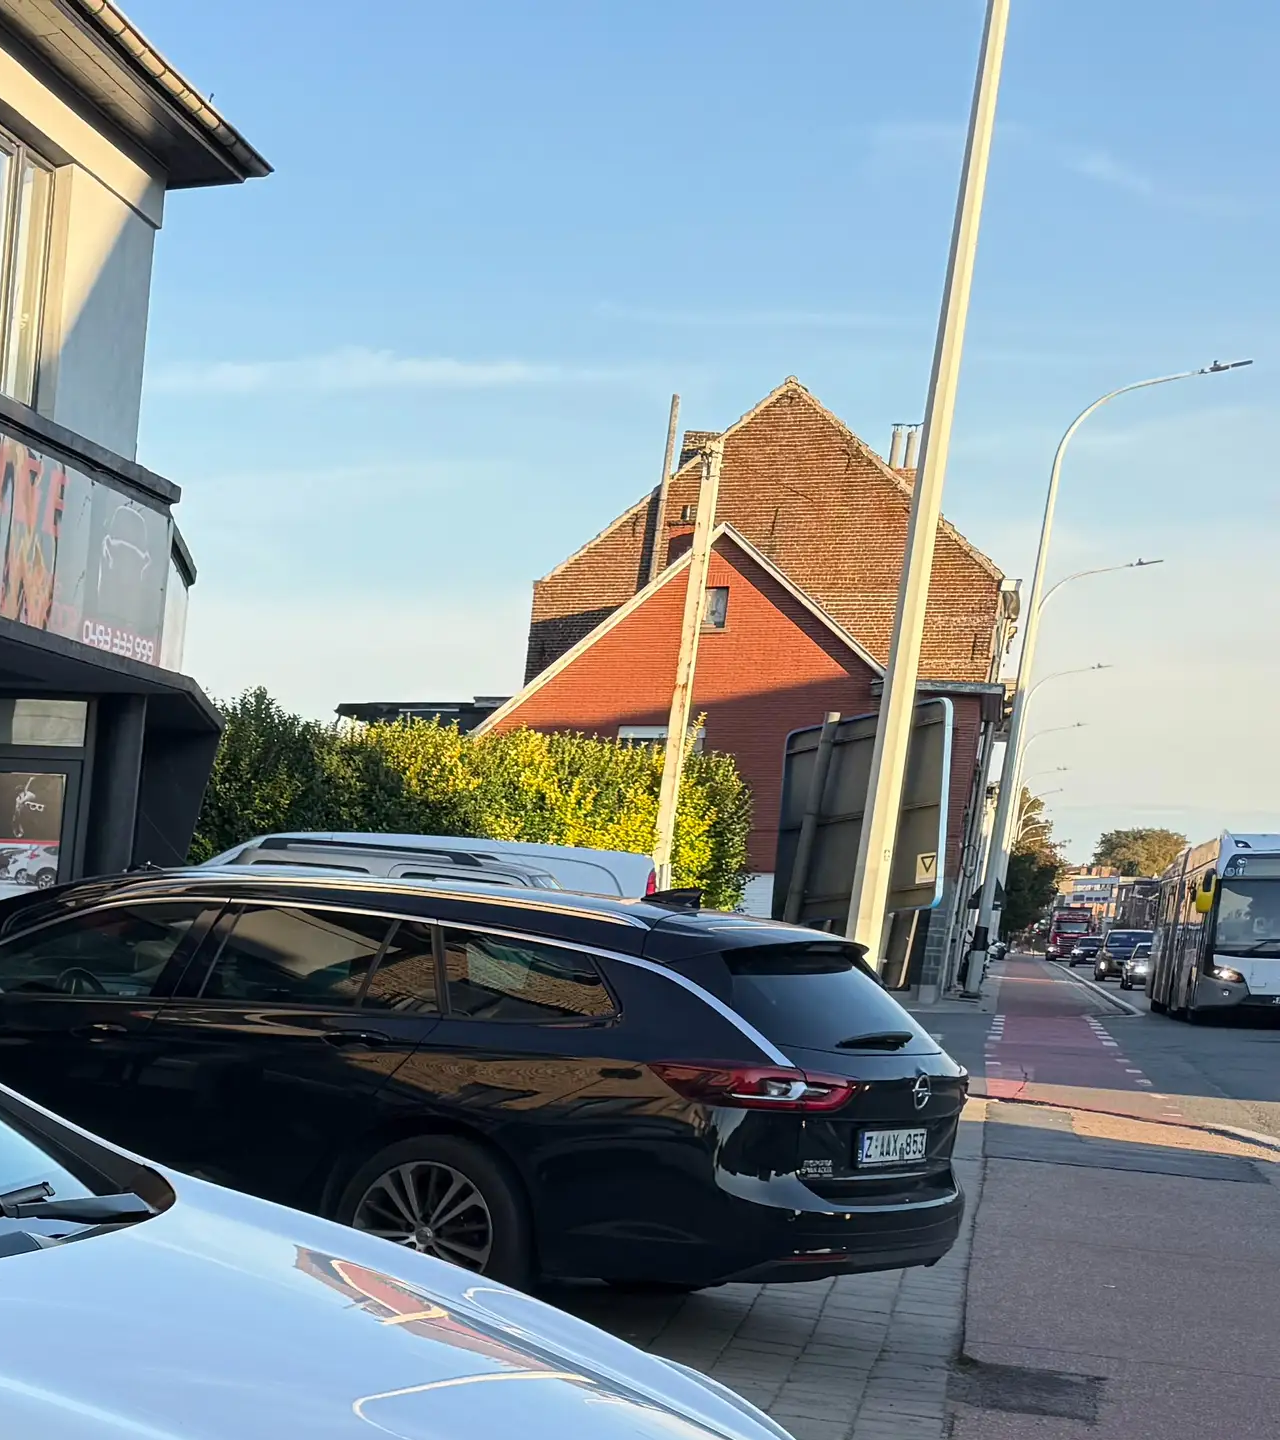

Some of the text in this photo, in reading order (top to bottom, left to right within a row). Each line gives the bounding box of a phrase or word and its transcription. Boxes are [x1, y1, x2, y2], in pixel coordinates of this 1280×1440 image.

[83, 620, 155, 664] 0493 333 999
